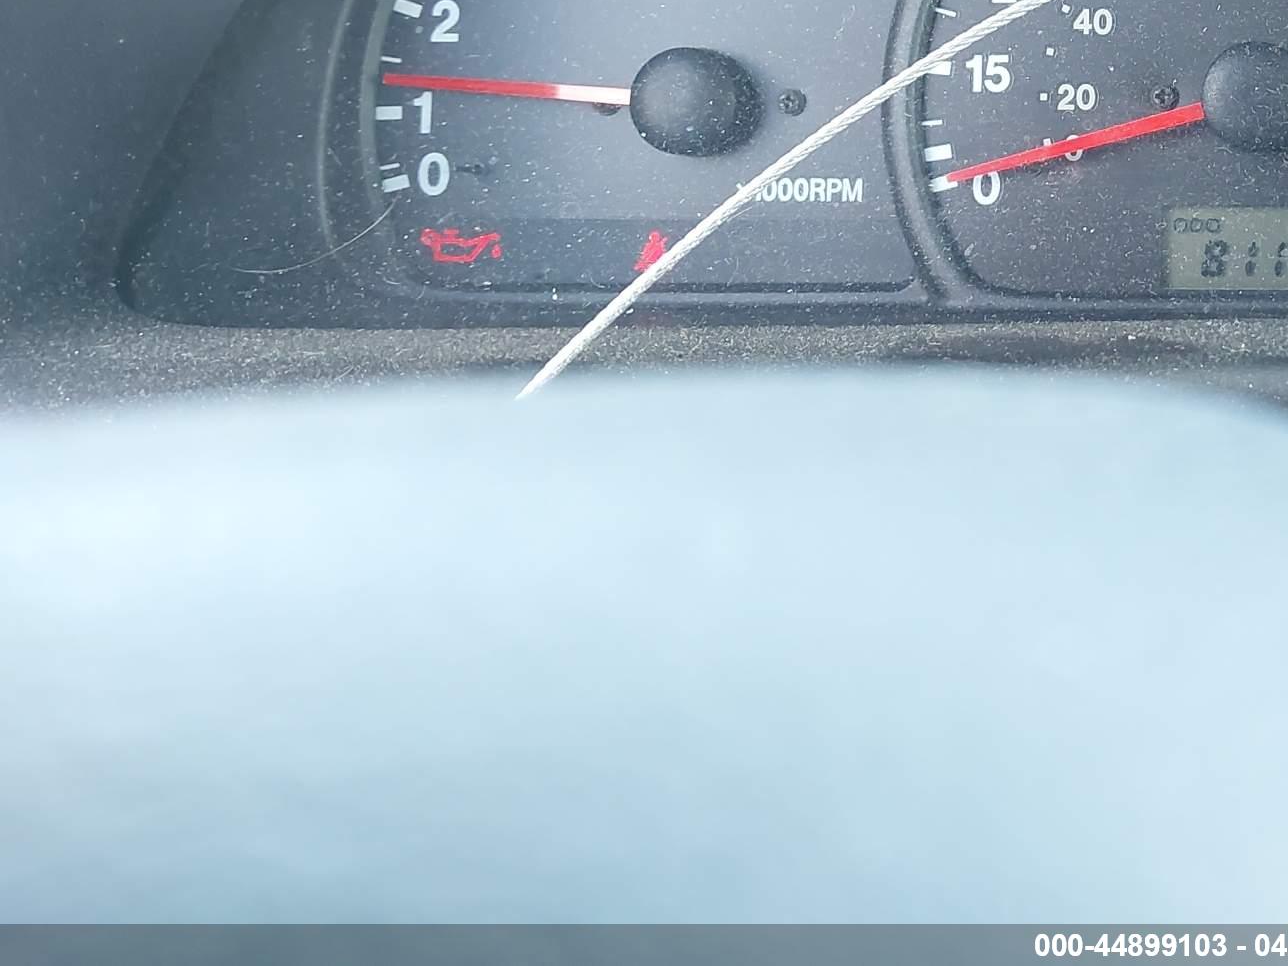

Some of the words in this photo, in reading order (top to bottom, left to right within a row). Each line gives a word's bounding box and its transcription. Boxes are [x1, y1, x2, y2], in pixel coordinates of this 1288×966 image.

[430, 0, 460, 42] 2
[1073, 8, 1113, 35] 40
[966, 54, 1011, 93] 15
[413, 91, 433, 133] 1
[1057, 84, 1096, 111] 20
[418, 152, 449, 195] 0
[972, 169, 1001, 205] 0
